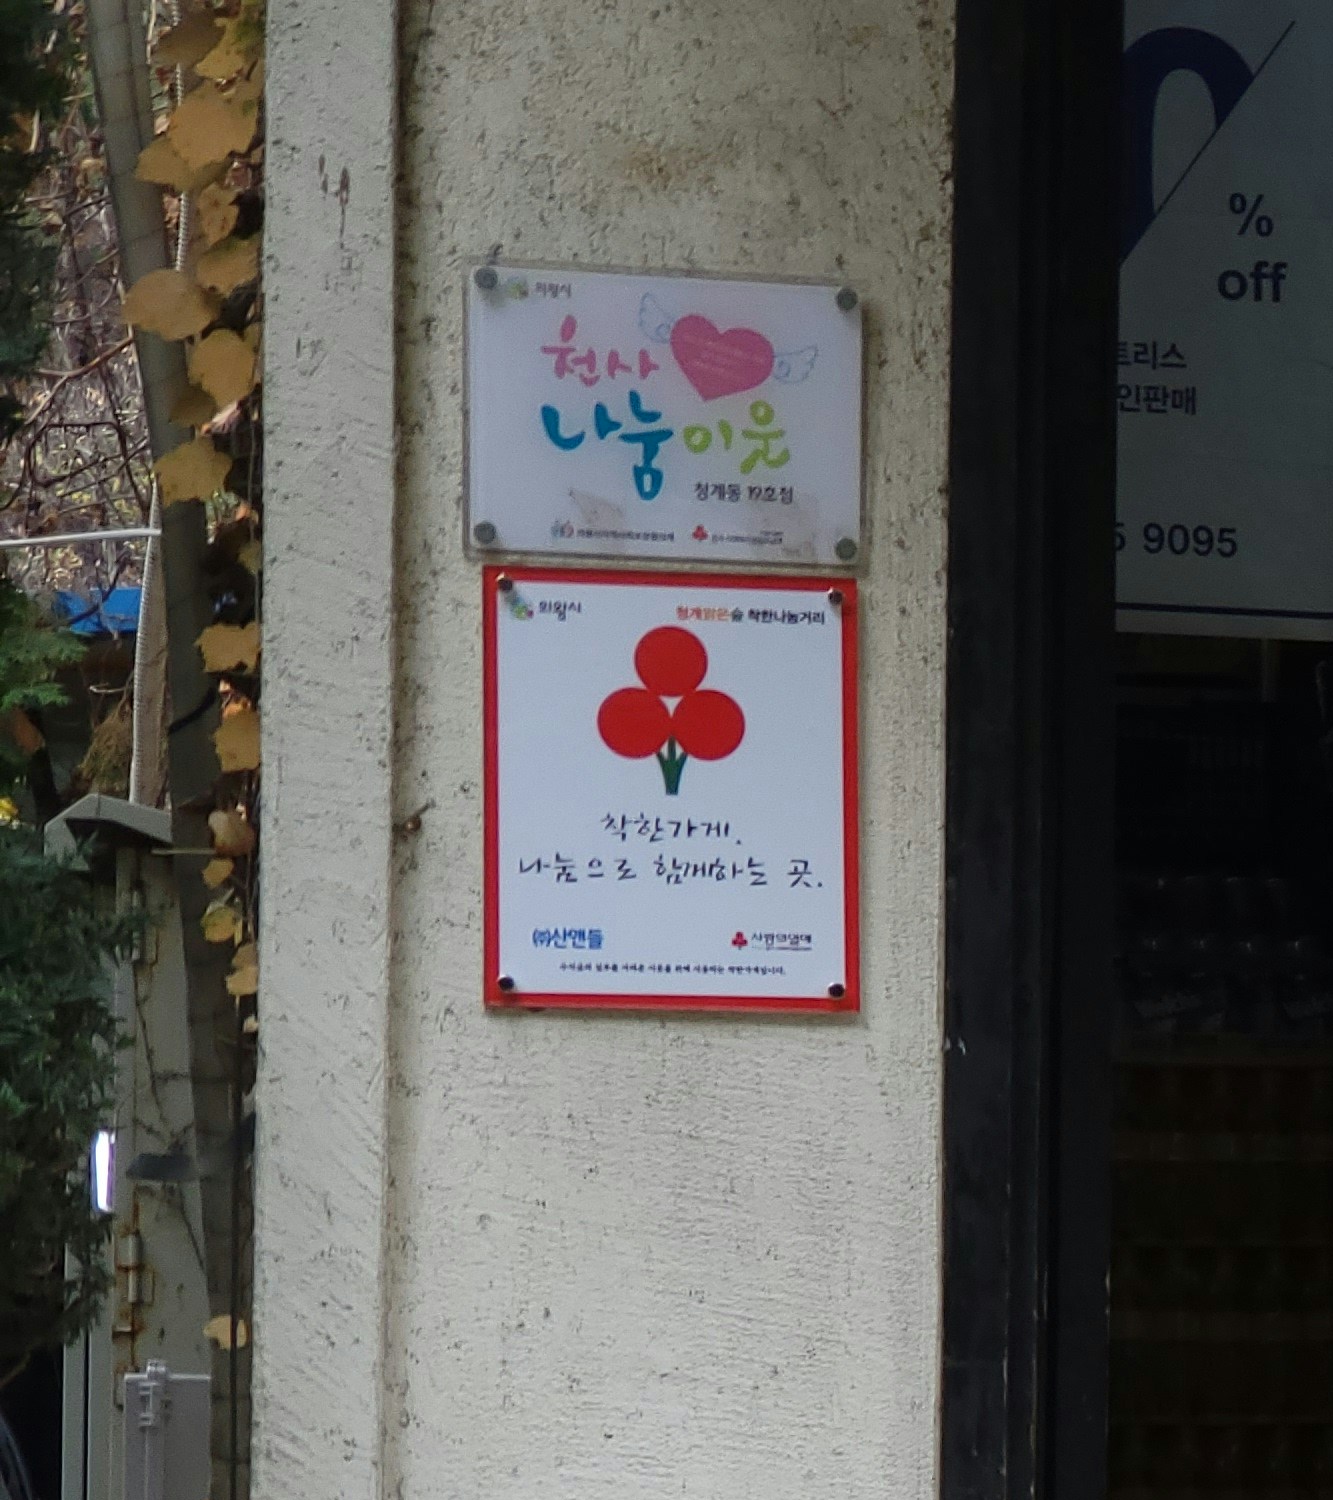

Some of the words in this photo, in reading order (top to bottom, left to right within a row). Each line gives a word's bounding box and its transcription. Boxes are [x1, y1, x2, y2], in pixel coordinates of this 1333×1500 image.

[1230, 193, 1273, 236] %
[1218, 261, 1287, 302] off
[541, 314, 660, 387] 천사
[1143, 522, 1237, 557] 9095
[539, 600, 582, 621] 의왕시
[519, 852, 637, 883] 나눔으로
[653, 853, 768, 886] 함께하는
